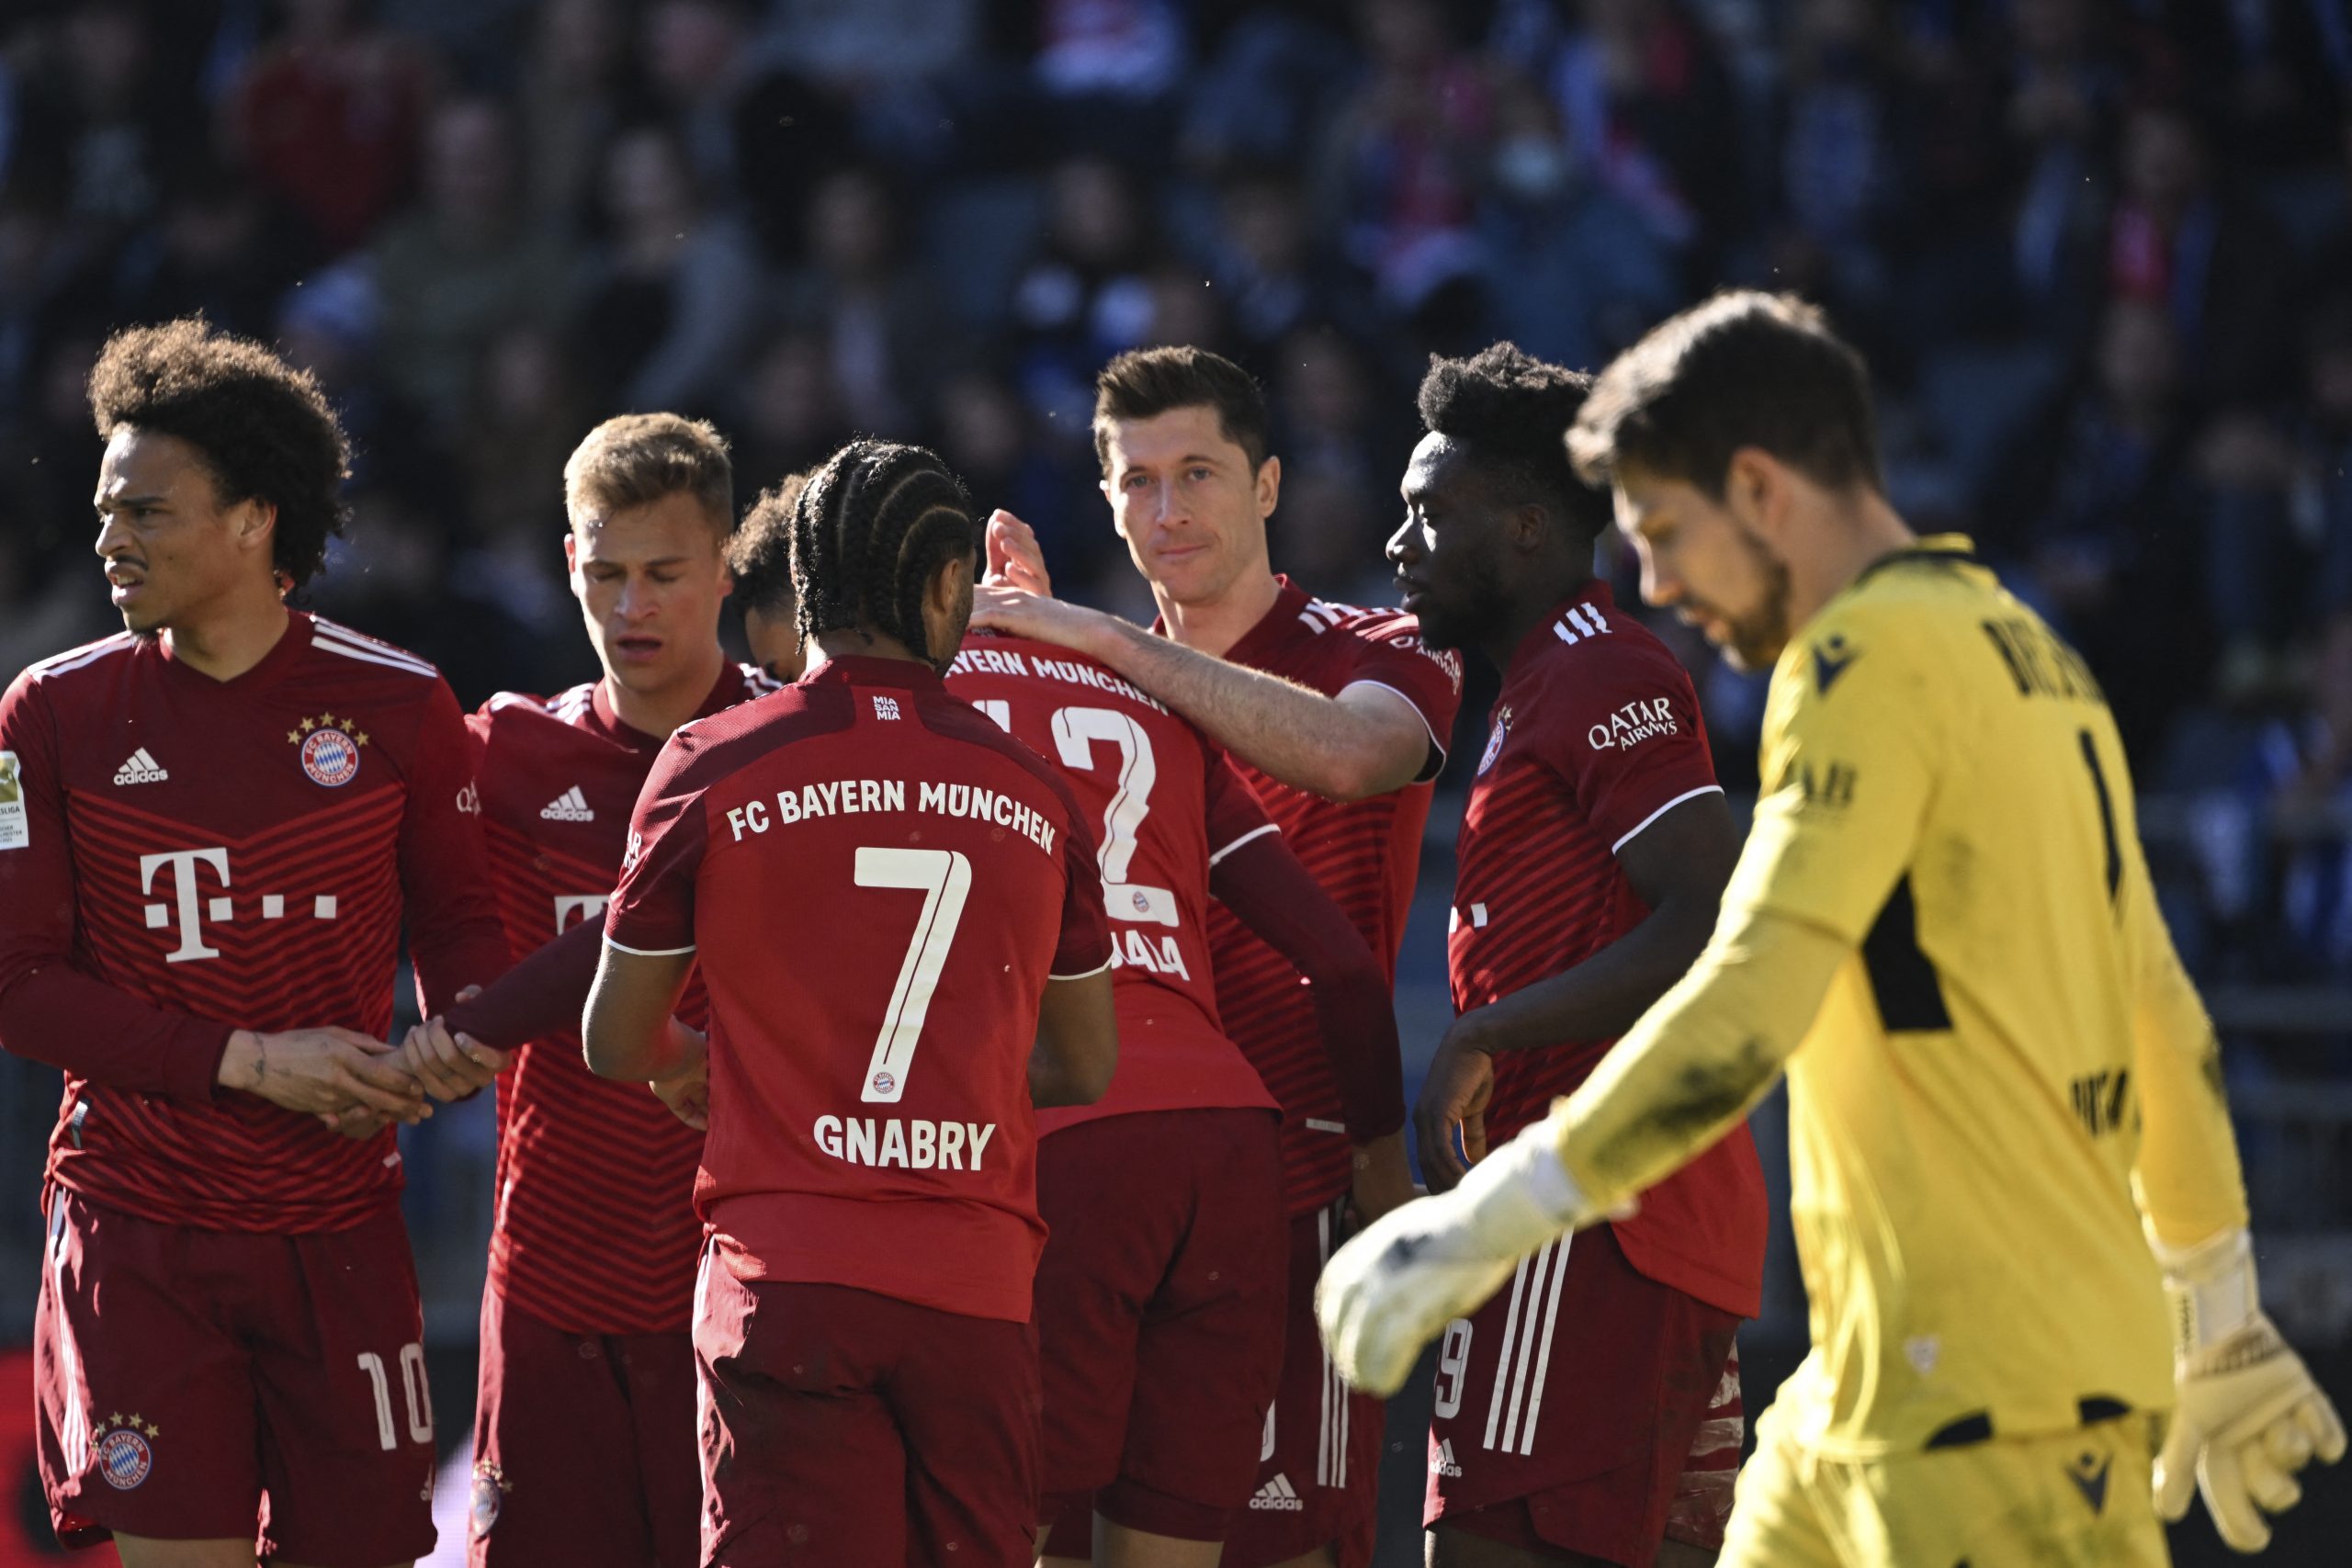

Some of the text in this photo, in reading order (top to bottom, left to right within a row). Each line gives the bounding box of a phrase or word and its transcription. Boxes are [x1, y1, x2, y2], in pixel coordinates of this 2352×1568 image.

[944, 649, 1028, 677] AYERN
[873, 695, 898, 705] MIA
[875, 704, 899, 712] SAN
[876, 710, 901, 721] MIA
[1589, 697, 1673, 750] QATAR
[113, 769, 168, 786] adidas
[540, 807, 594, 822] adidas
[726, 780, 1056, 856] FC BAYERN MÜNCHEN
[972, 700, 1180, 928] 2
[854, 847, 972, 1102] 7
[813, 1114, 996, 1171] GNABRY
[356, 1343, 433, 1451] 10
[1249, 1497, 1303, 1511] adidas
